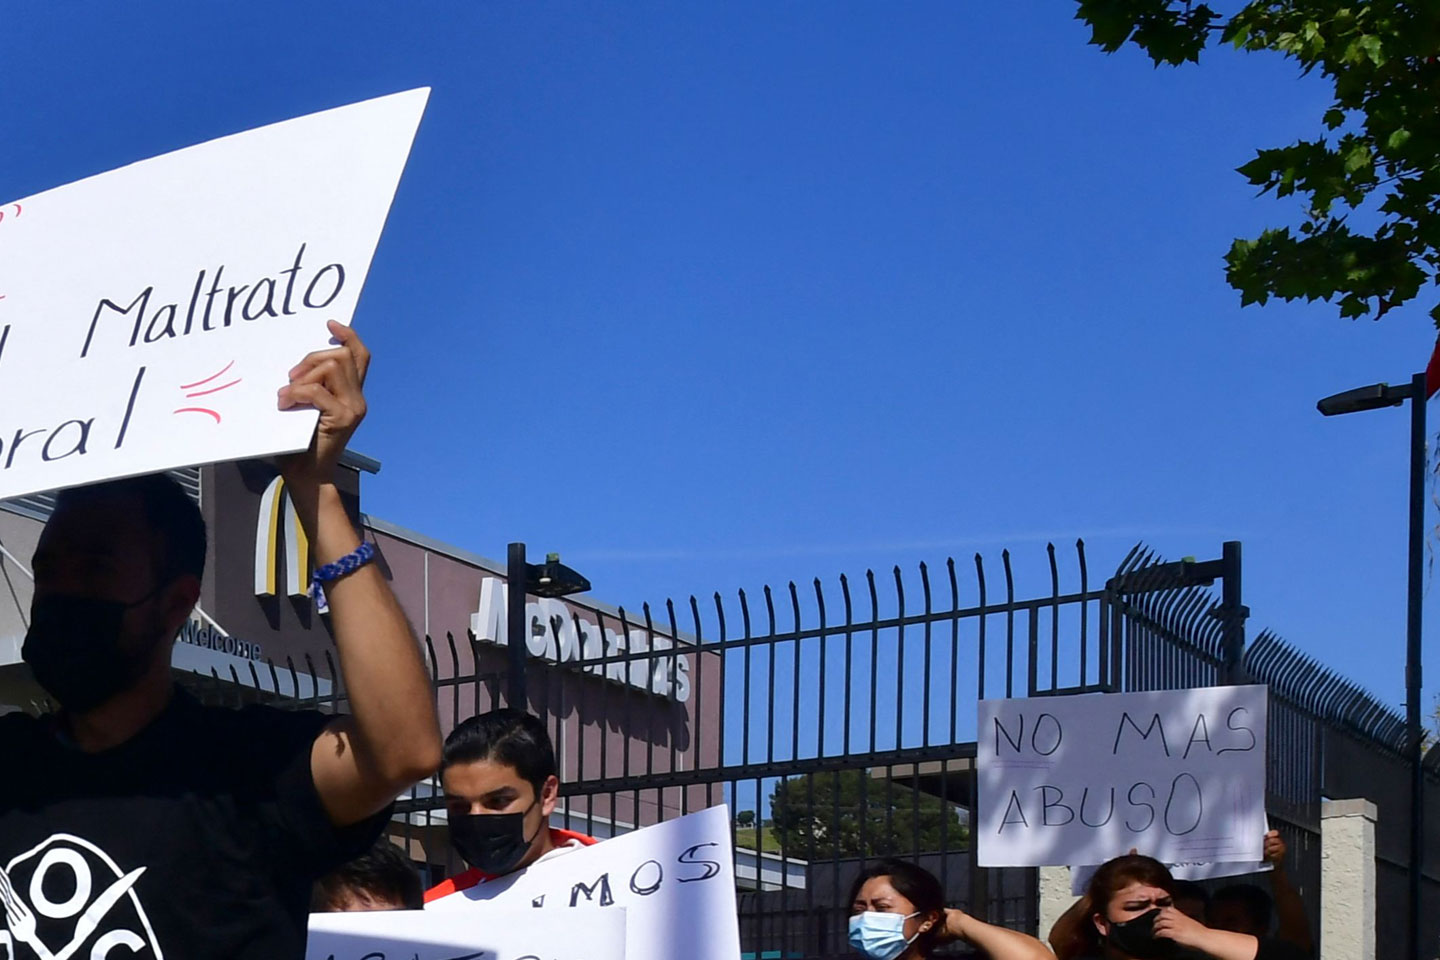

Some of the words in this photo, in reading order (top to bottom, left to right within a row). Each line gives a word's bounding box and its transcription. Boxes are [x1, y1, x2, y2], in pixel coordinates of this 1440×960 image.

[80, 243, 345, 359] Maltrato
[178, 616, 262, 661] Welcome
[994, 713, 1062, 757] NO
[1113, 706, 1257, 760] MAS
[998, 772, 1203, 836] ABUSO
